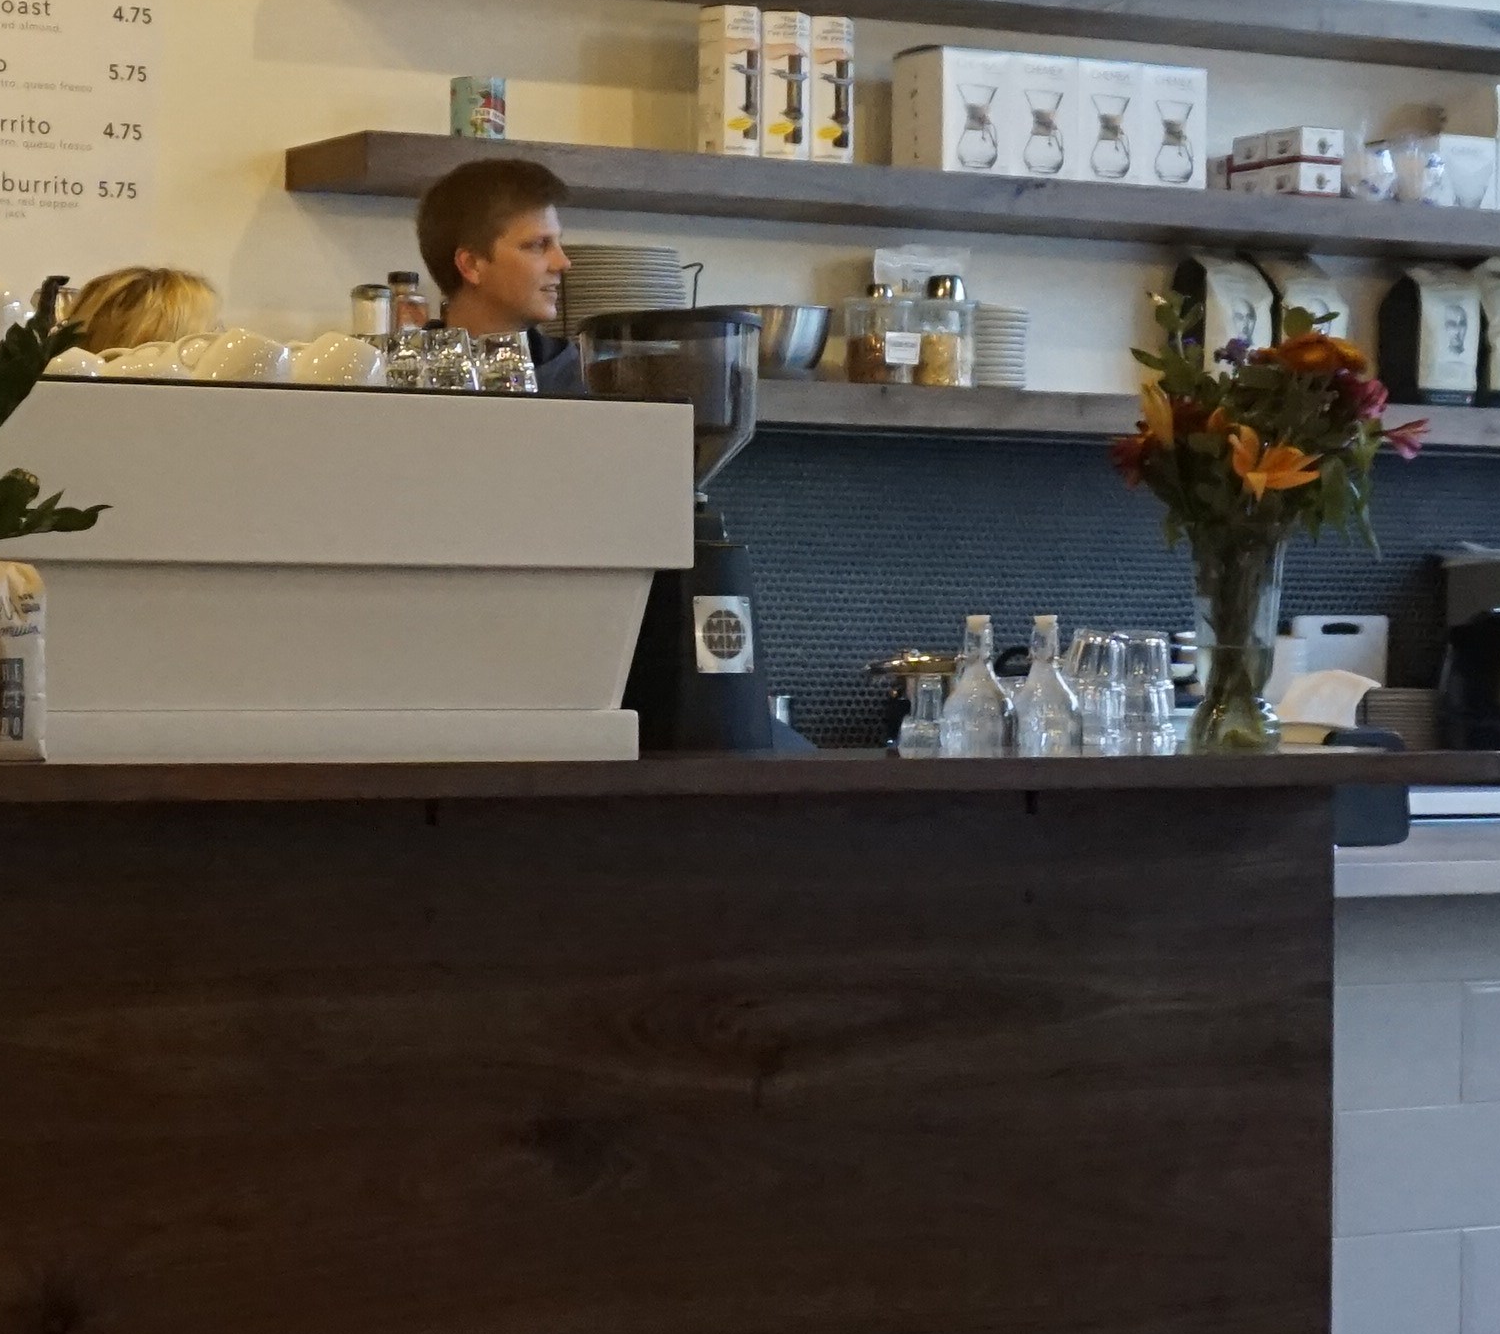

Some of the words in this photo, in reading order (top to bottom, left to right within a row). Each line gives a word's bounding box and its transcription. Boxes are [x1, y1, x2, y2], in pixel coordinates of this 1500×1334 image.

[112, 5, 153, 25] 4.75
[108, 63, 148, 83] 5.75
[102, 122, 143, 142] 4.75
[1, 171, 84, 196] burrito
[98, 180, 138, 200] 5.75
